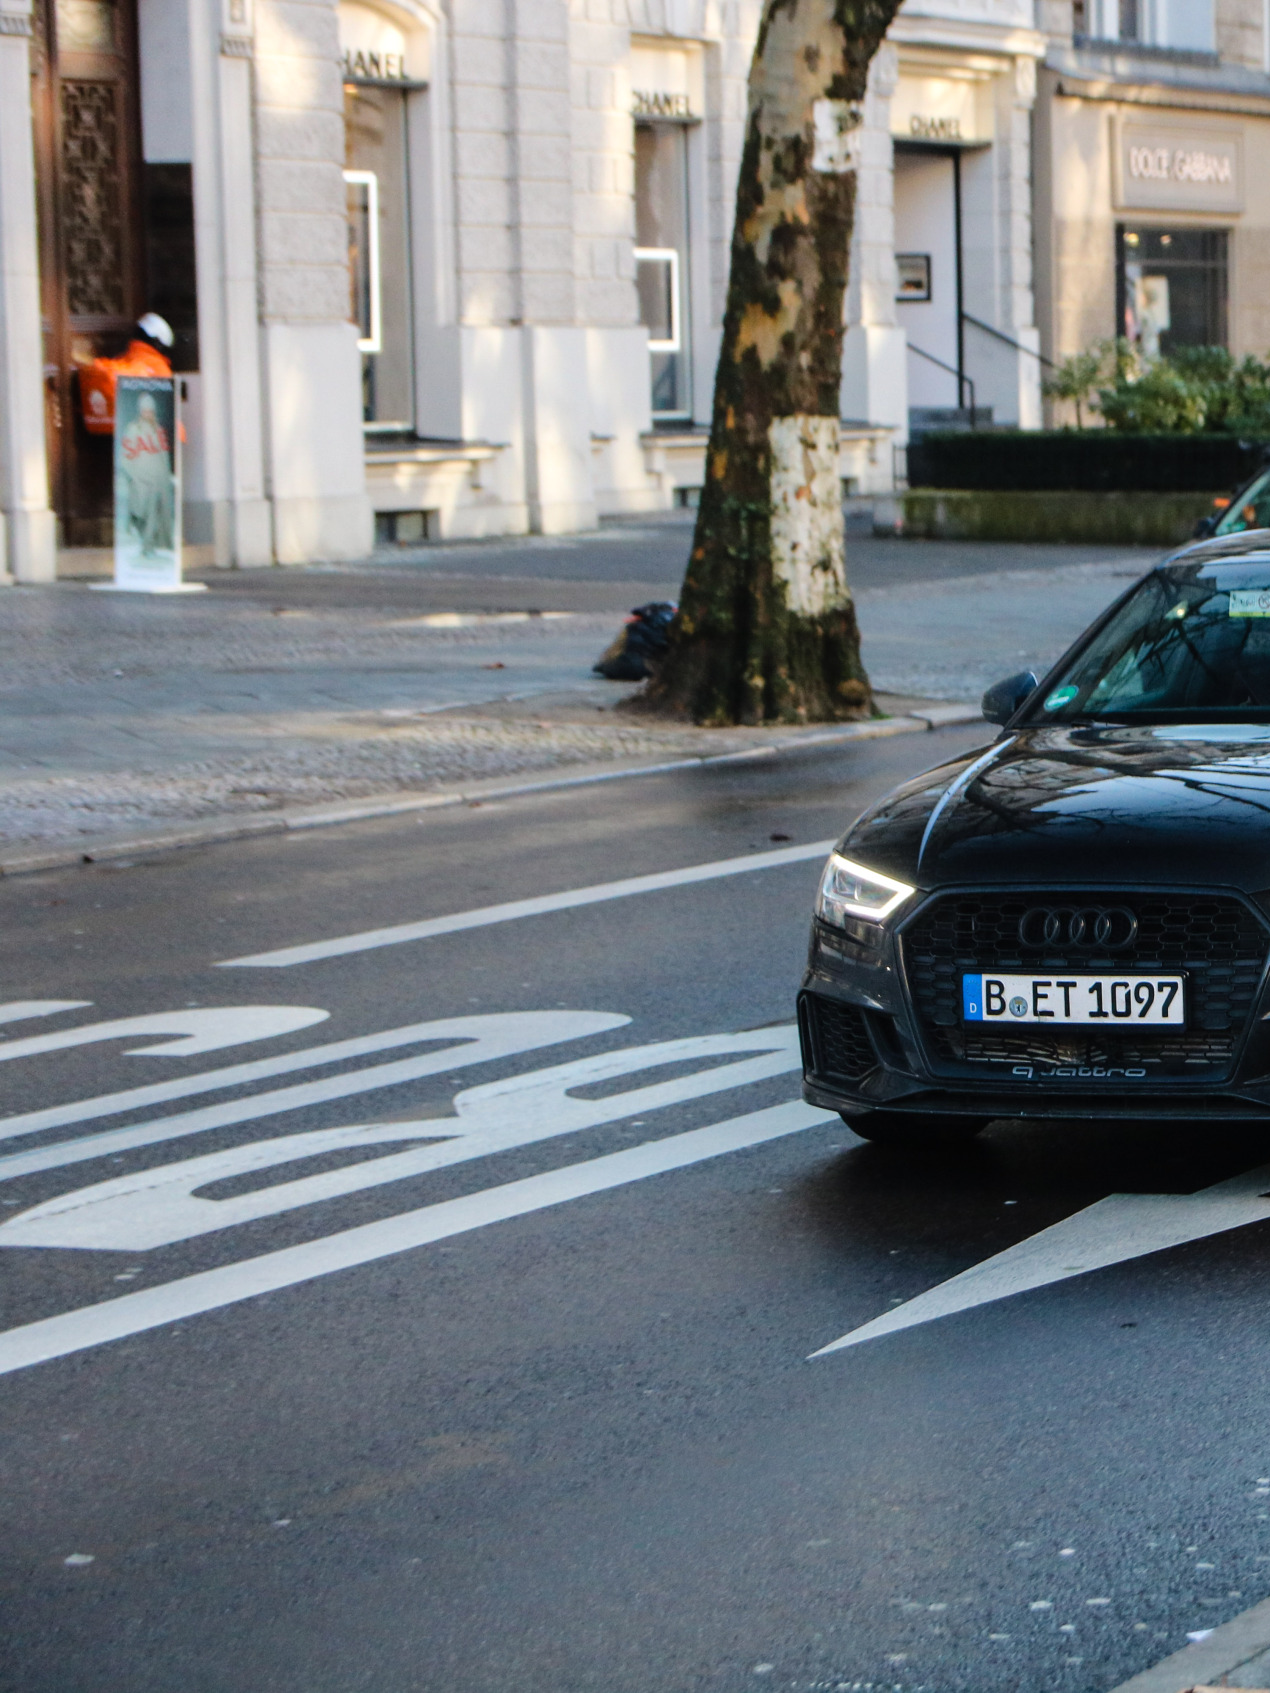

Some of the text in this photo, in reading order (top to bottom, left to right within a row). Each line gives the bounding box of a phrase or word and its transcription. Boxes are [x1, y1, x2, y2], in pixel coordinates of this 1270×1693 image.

[336, 49, 408, 79] HANEL
[122, 428, 169, 460] SALE
[985, 979, 1180, 1019] B ET 1097
